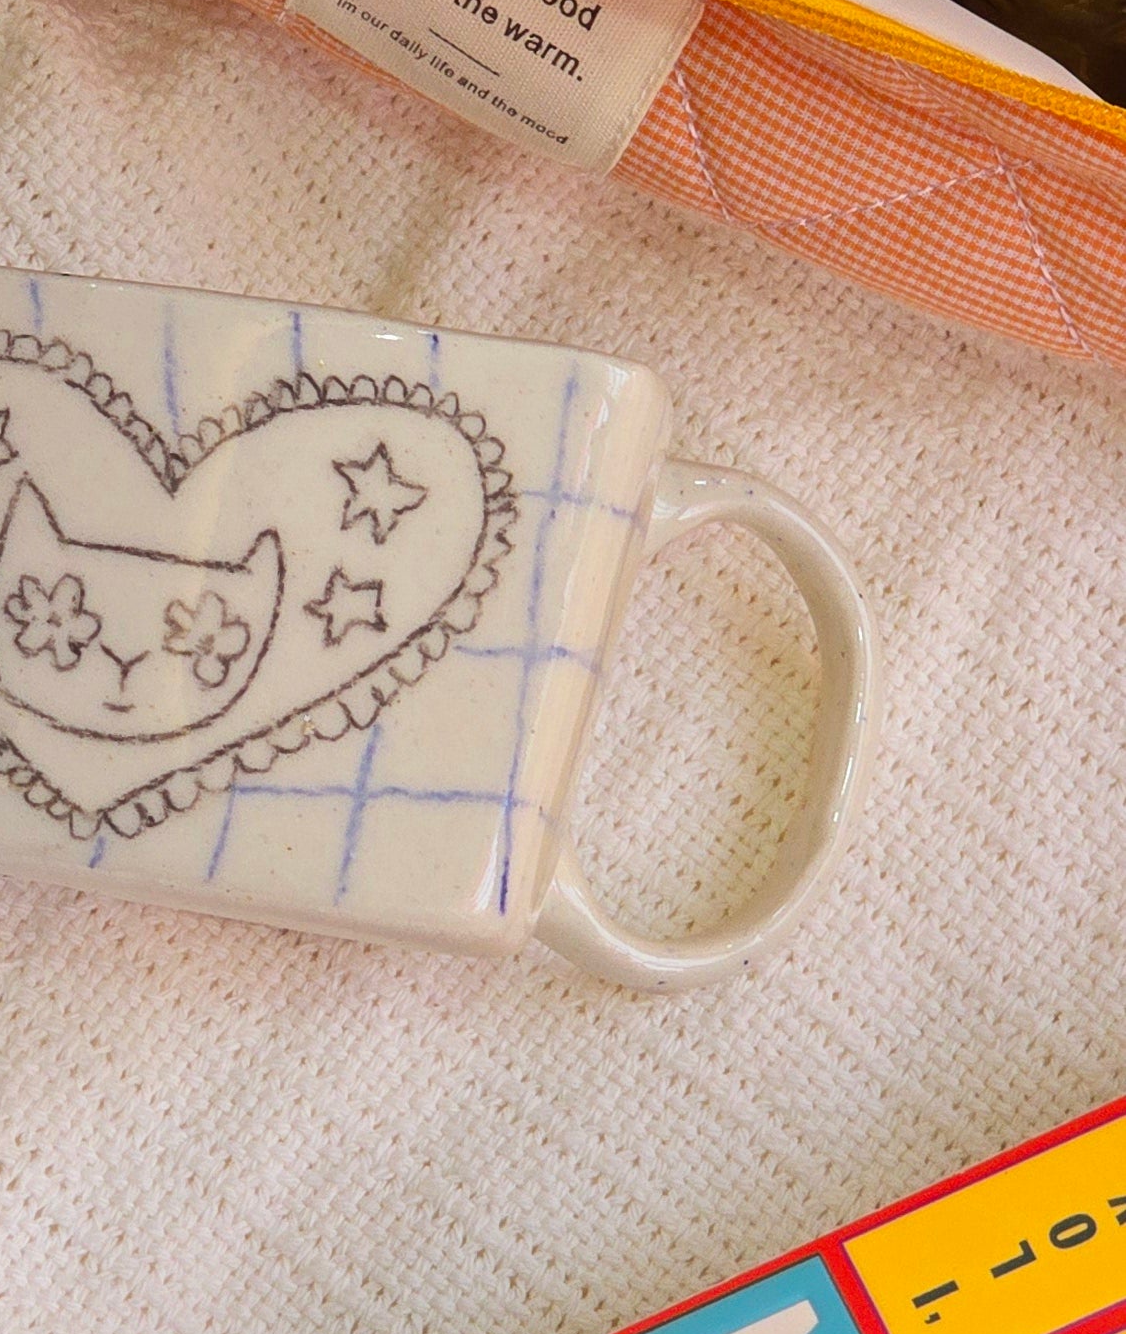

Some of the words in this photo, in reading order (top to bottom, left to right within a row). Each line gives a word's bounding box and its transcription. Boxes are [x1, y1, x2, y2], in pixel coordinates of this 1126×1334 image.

[361, 10, 389, 31] our
[389, 28, 429, 61] daily
[430, 55, 455, 79] life
[457, 75, 491, 100] and
[491, 95, 518, 118] the
[503, 17, 584, 82] warm.
